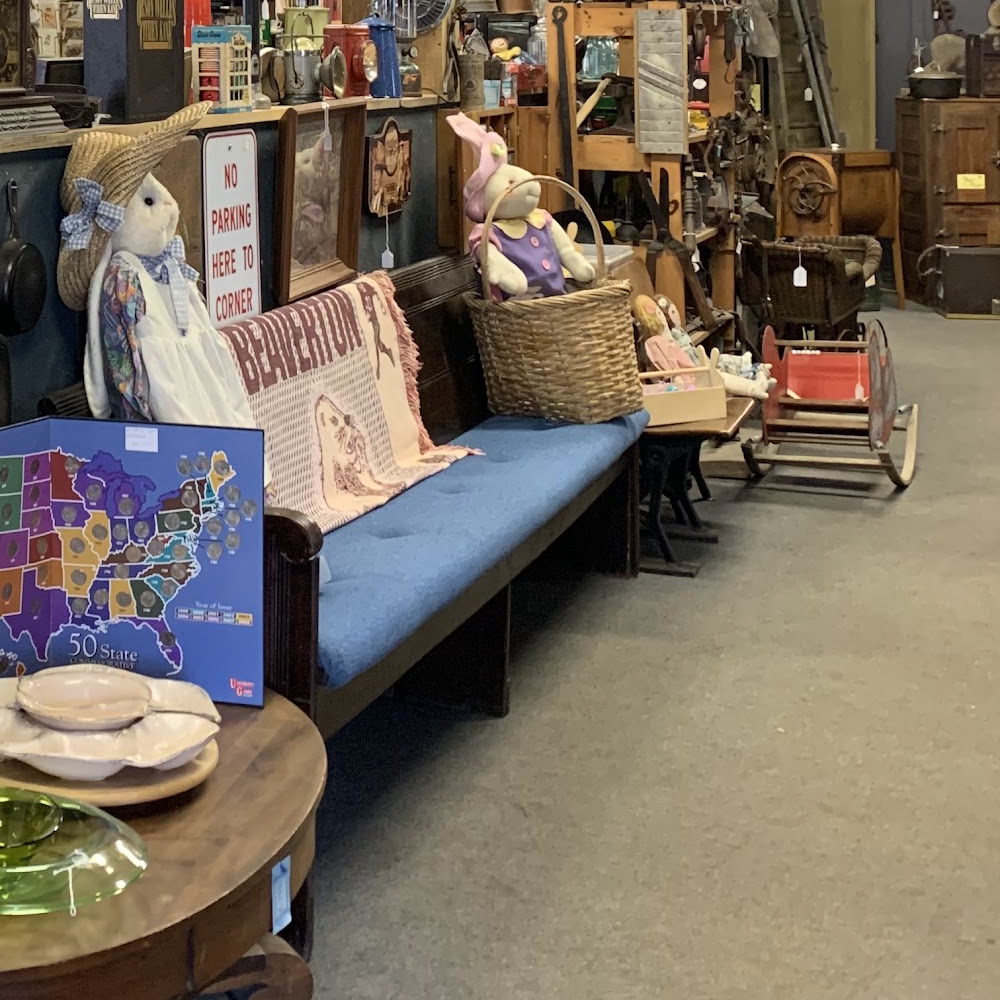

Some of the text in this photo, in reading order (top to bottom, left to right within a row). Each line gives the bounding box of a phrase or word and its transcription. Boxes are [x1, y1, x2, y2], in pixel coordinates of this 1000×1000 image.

[224, 163, 238, 190] NO
[211, 203, 252, 236] PARKING
[212, 244, 254, 280] HERE TO
[215, 287, 253, 323] CORNER
[226, 287, 362, 395] BEAVERTON
[68, 632, 138, 662] 50 State
